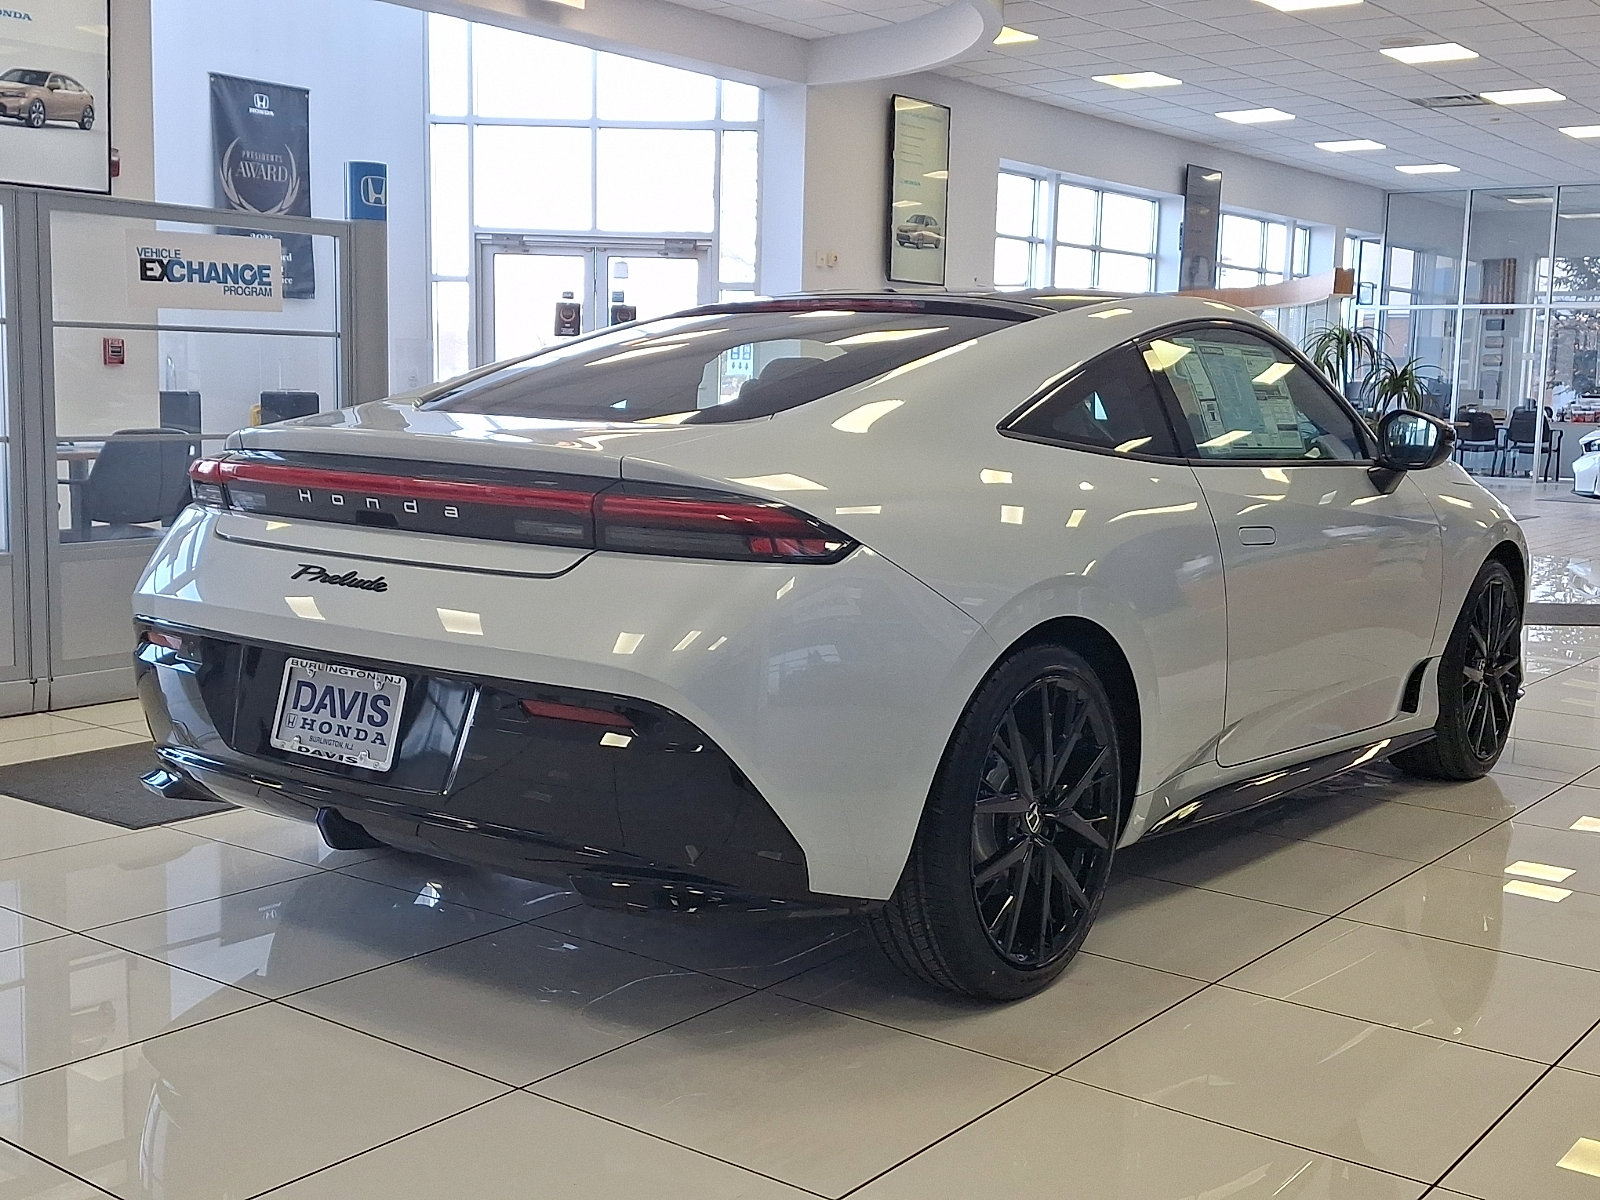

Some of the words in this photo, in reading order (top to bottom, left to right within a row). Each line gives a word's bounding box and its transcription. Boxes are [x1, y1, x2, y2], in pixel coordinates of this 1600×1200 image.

[0, 9, 32, 21] NDA
[235, 161, 288, 182] AWARD
[136, 246, 182, 259] VEHICLE
[140, 257, 272, 287] EXCHANGE
[223, 285, 273, 298] PROGRAM
[298, 489, 459, 518] Honda
[290, 563, 388, 593] Prelude
[384, 675, 402, 685] NJ
[291, 679, 391, 728] DAVIS
[299, 716, 387, 747] HONDA
[297, 745, 358, 765] DAVIS
[344, 742, 354, 751] NJ
